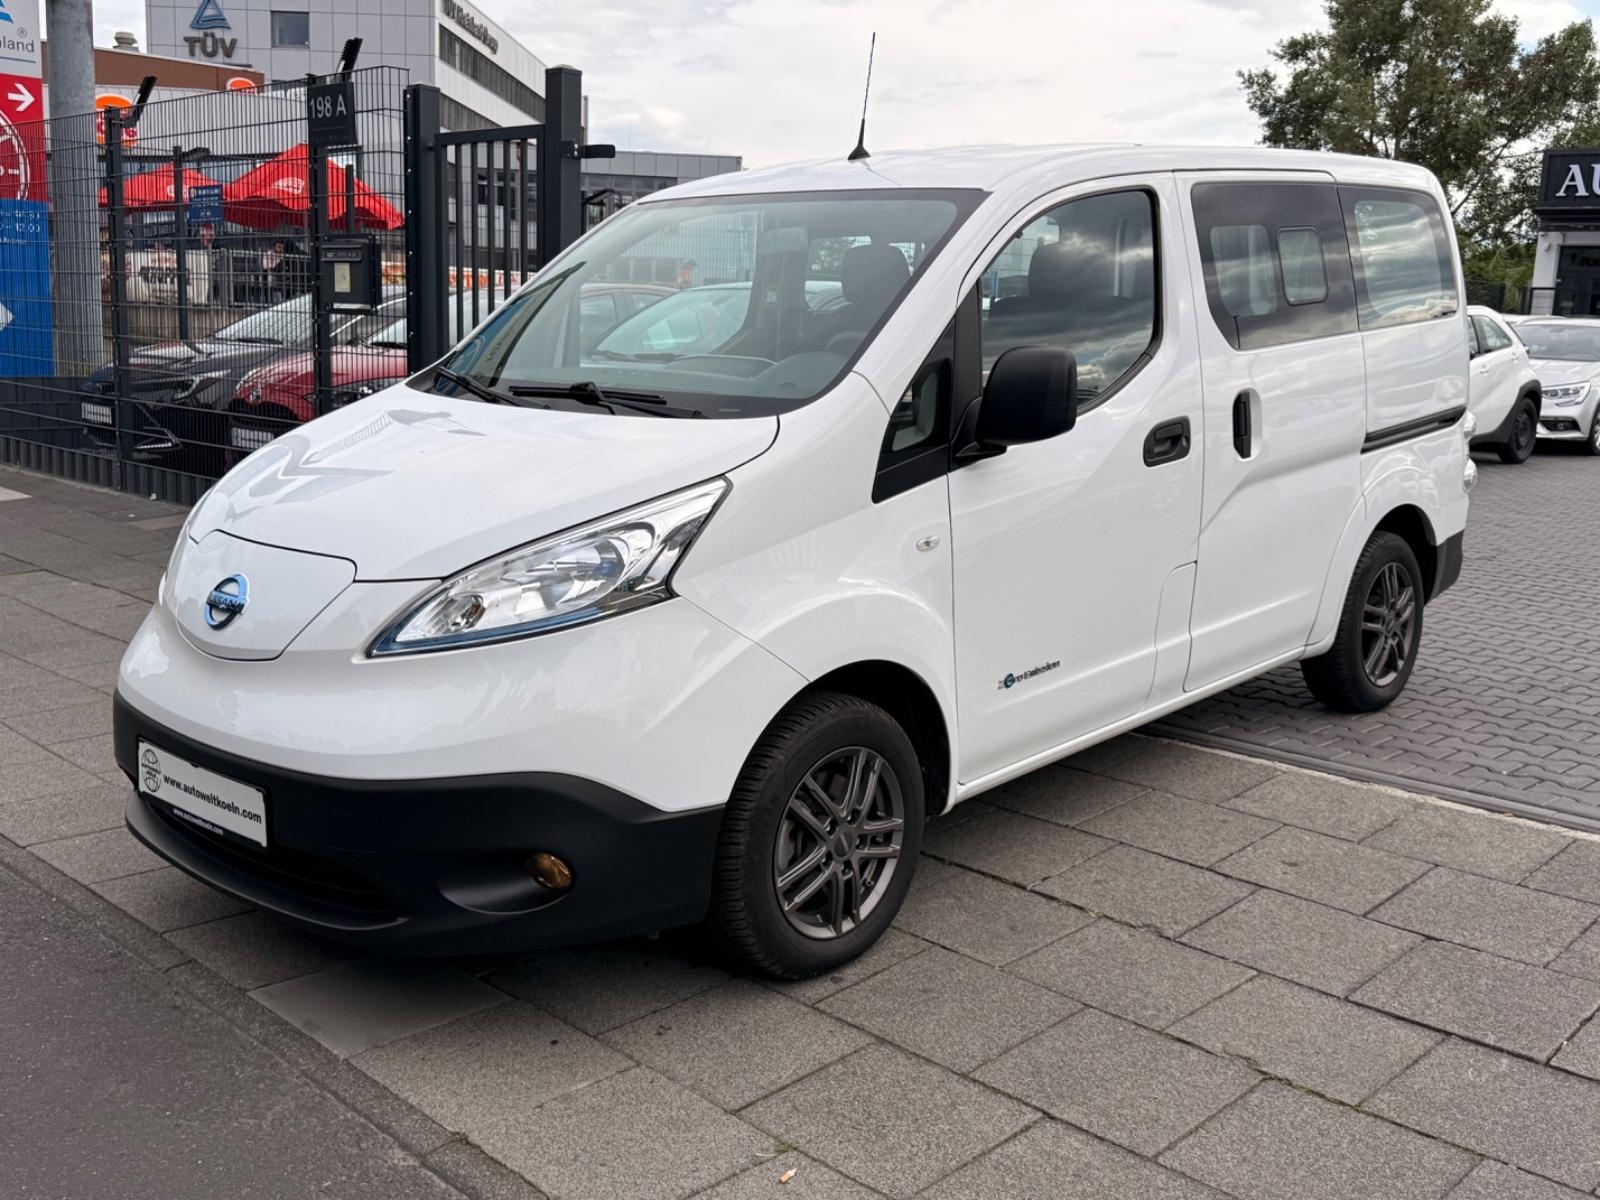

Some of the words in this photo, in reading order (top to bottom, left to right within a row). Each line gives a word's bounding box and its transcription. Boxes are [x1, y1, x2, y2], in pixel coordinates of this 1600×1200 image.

[0, 35, 35, 53] land
[183, 31, 238, 58] TÜV
[309, 95, 333, 119] 198
[336, 93, 347, 117] A
[163, 774, 262, 824] www.autoweltkoeln.com
